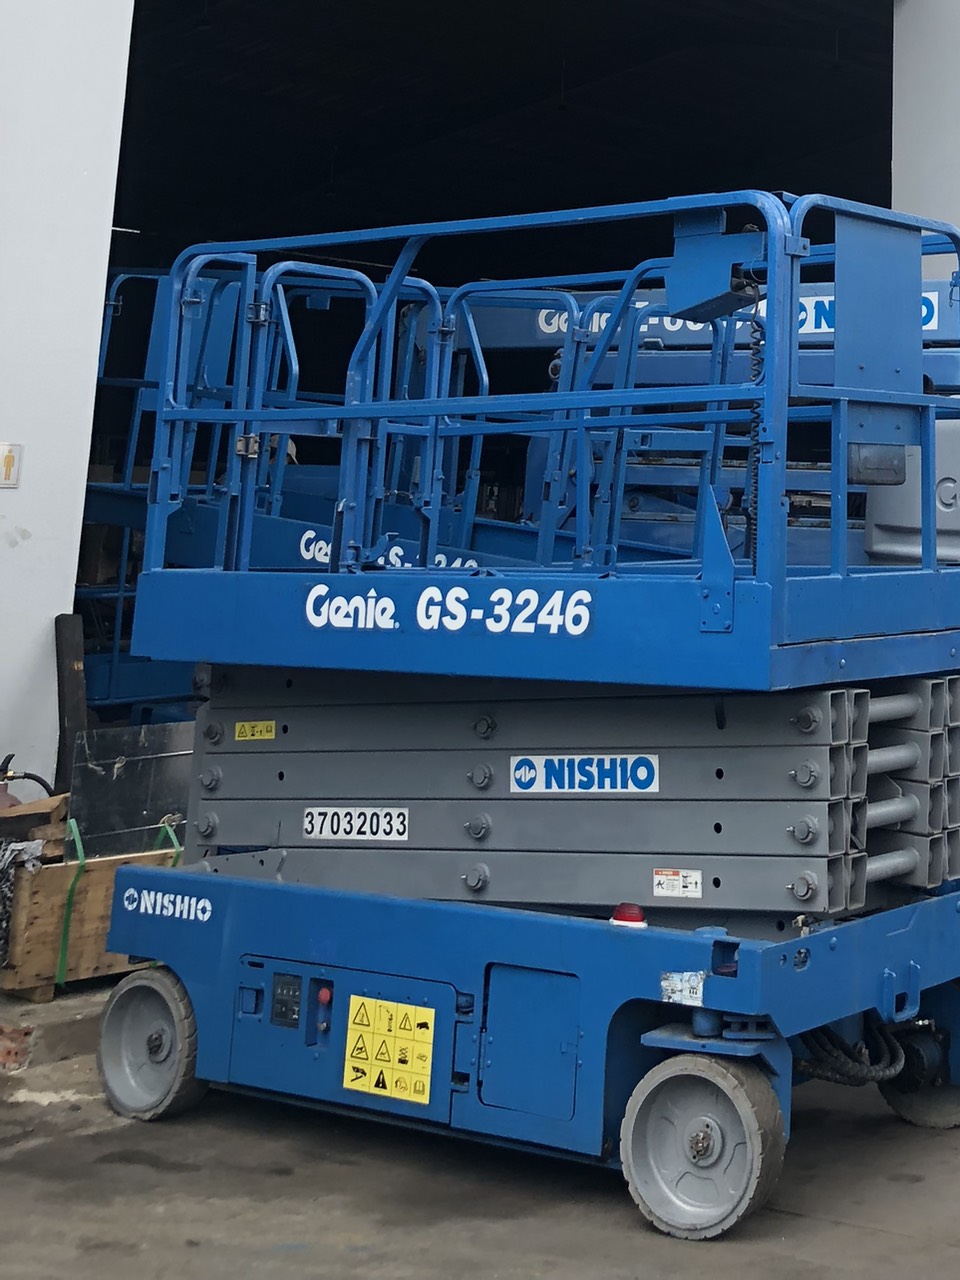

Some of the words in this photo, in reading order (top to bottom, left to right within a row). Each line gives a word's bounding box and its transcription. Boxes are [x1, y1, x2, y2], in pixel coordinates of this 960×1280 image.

[305, 584, 397, 629] Genie
[416, 586, 592, 635] GS-3246
[544, 756, 655, 790] NISHIO
[304, 810, 407, 837] 37032033
[140, 889, 212, 922] NISHIO
